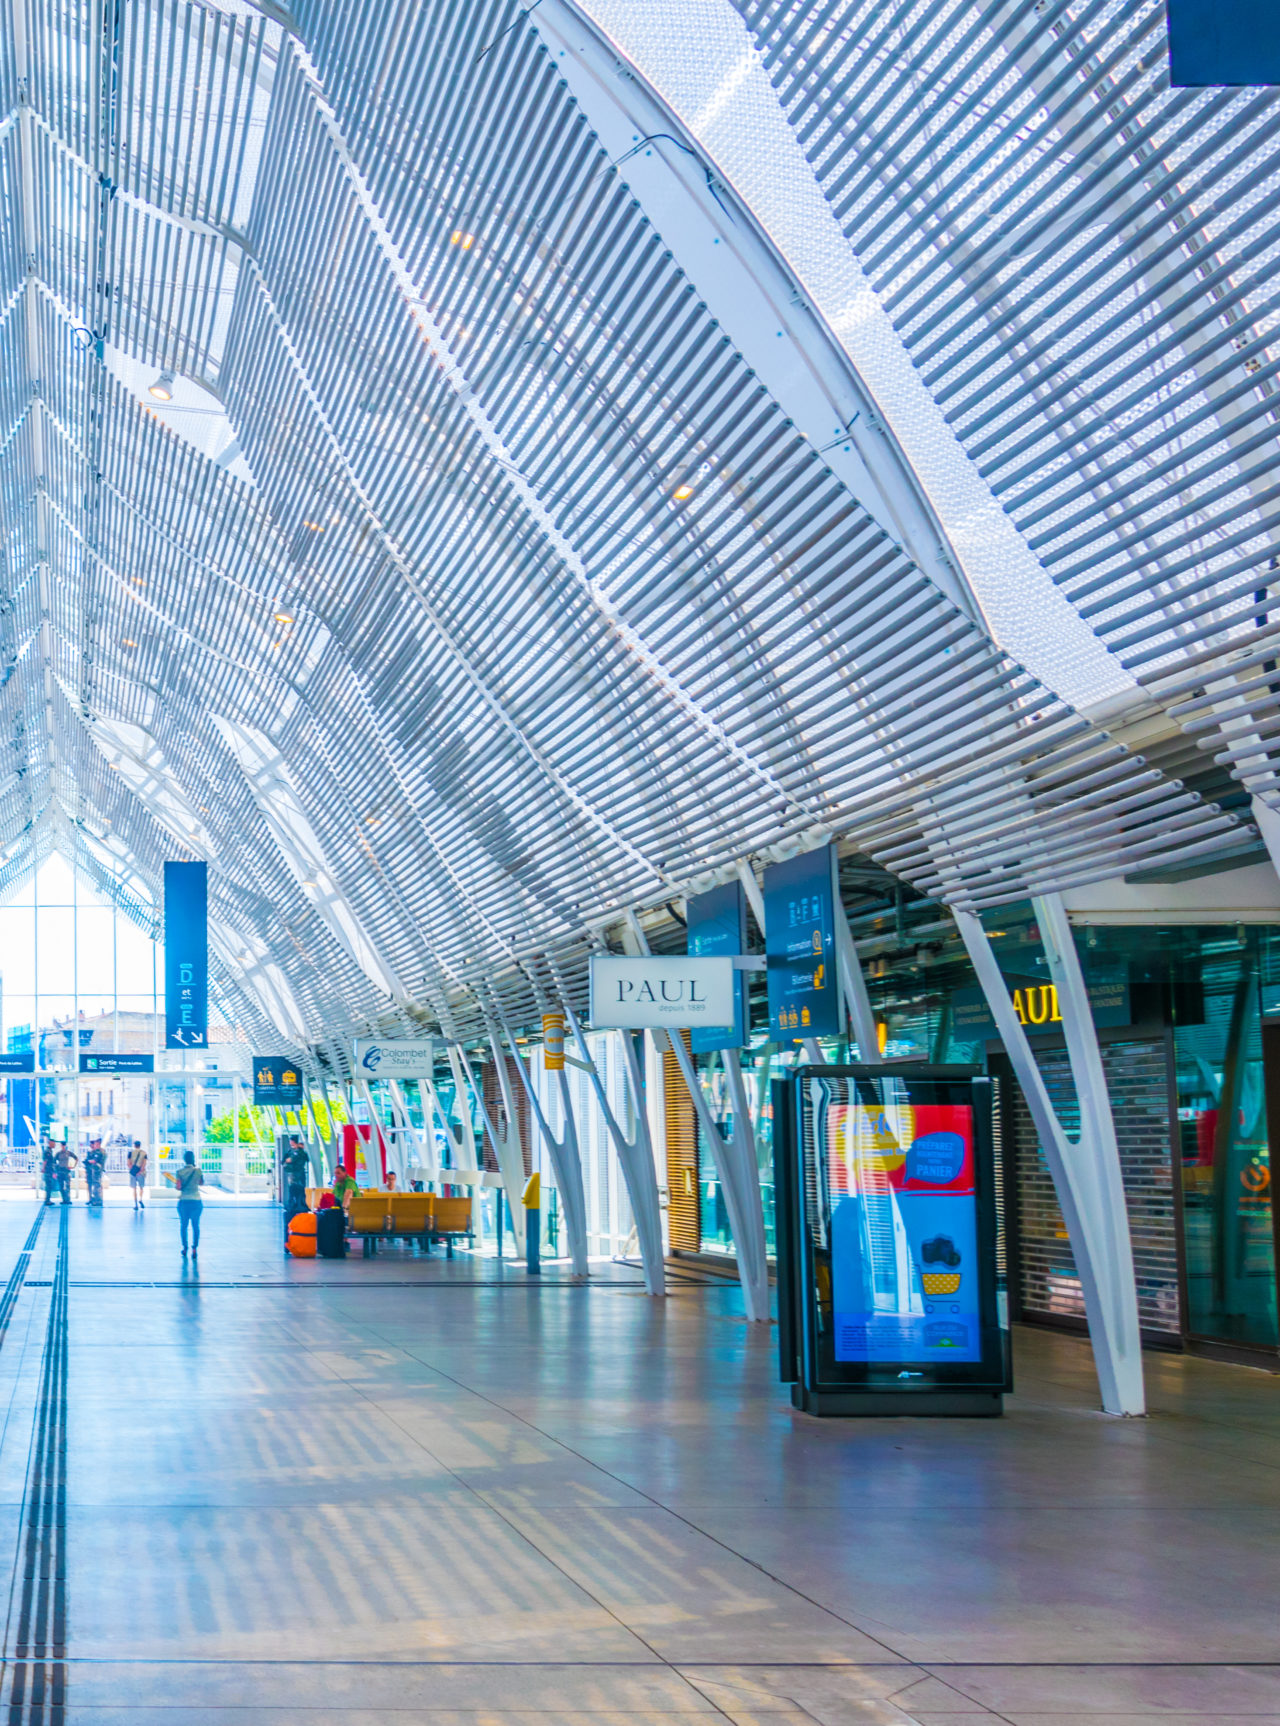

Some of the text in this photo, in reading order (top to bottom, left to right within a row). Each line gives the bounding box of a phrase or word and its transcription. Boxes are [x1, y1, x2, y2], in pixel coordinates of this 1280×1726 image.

[180, 970, 193, 983] D
[182, 988, 192, 996] et
[616, 980, 708, 1002] PAUL
[1013, 985, 1063, 1024] AUL
[182, 1010, 192, 1024] E
[381, 1048, 426, 1058] Colombet
[917, 1165, 953, 1177] PANIER
